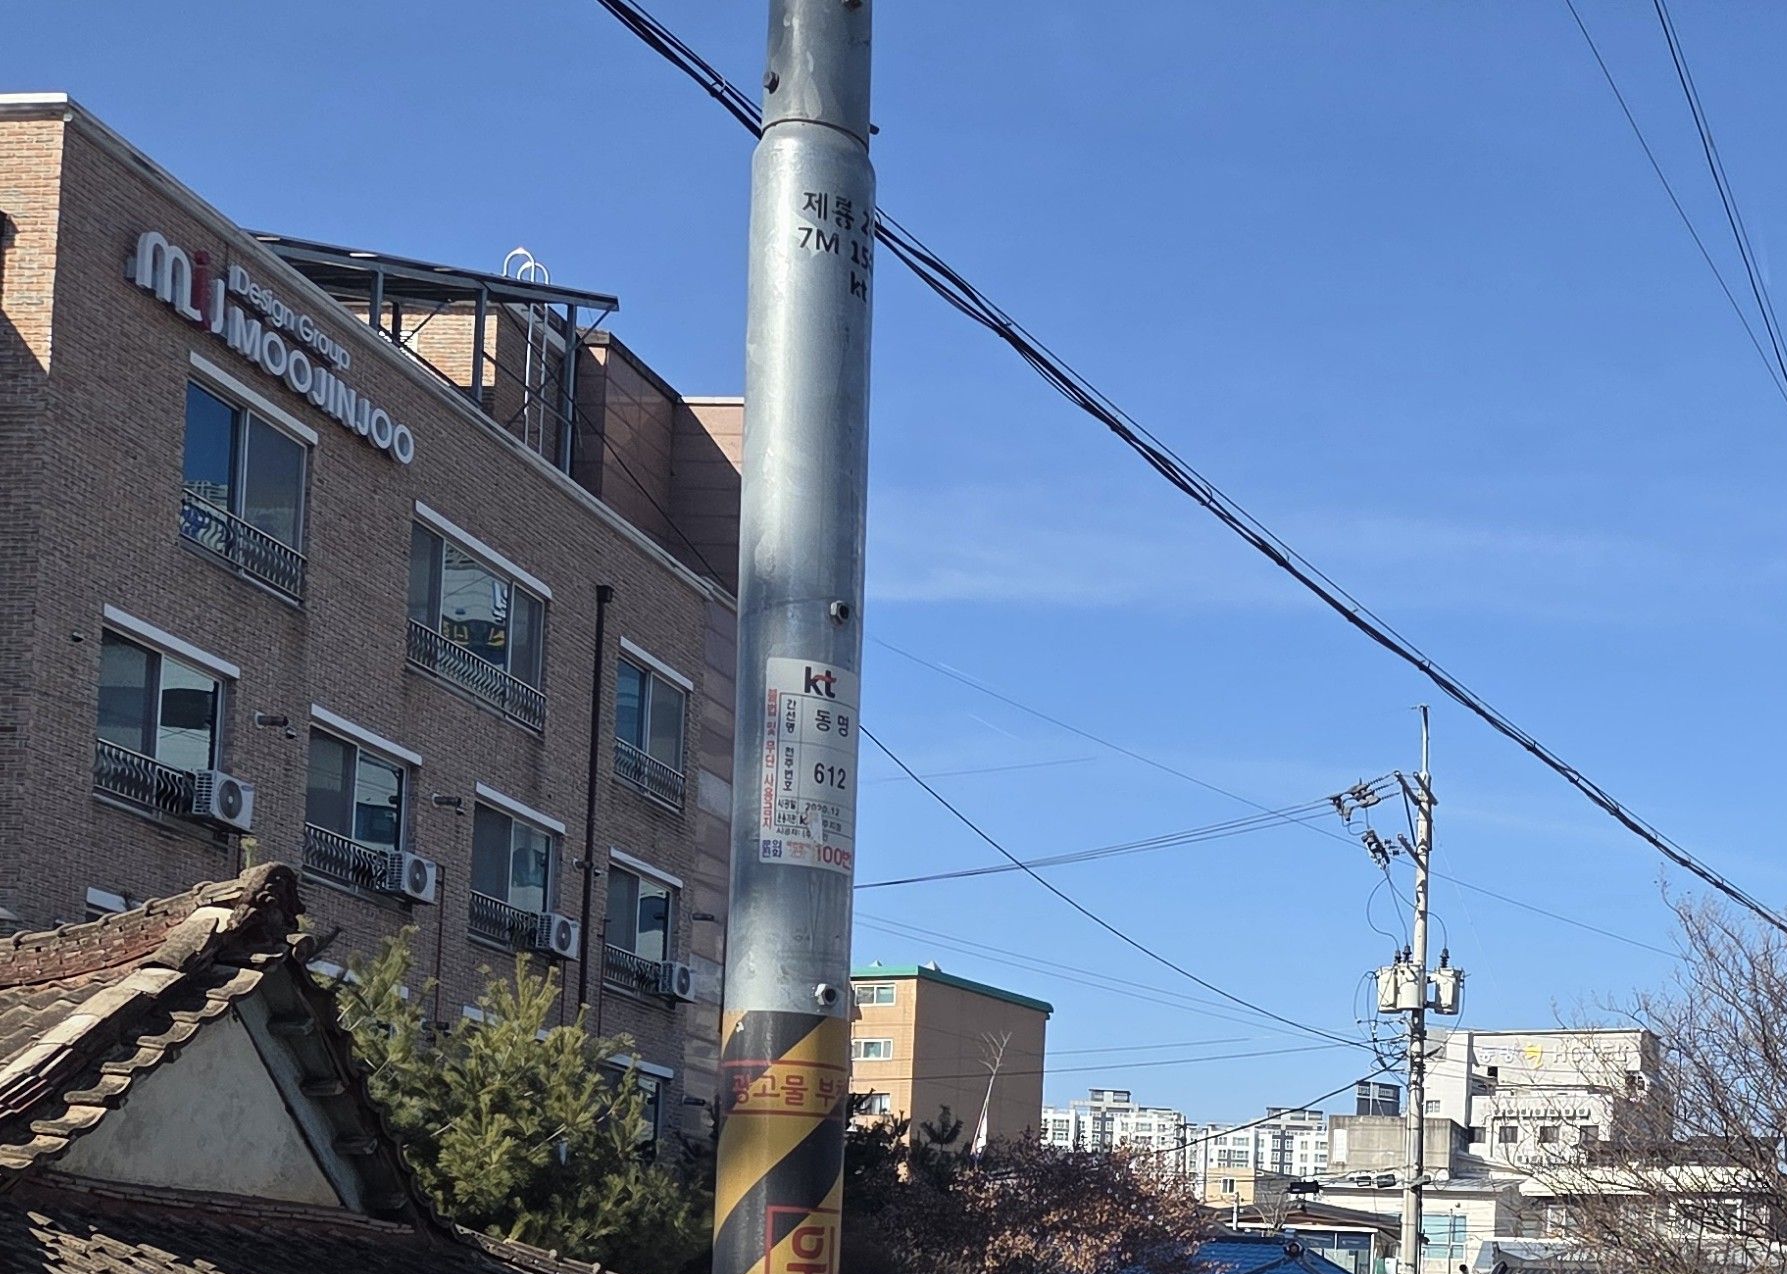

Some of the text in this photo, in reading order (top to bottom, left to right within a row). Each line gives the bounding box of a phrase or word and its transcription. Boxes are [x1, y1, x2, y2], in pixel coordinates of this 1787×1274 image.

[229, 264, 351, 371] Design Group
[227, 304, 415, 466] MOOJINJOO
[804, 666, 837, 699] kt
[814, 762, 847, 791] 612
[733, 1073, 808, 1106] 광고물
